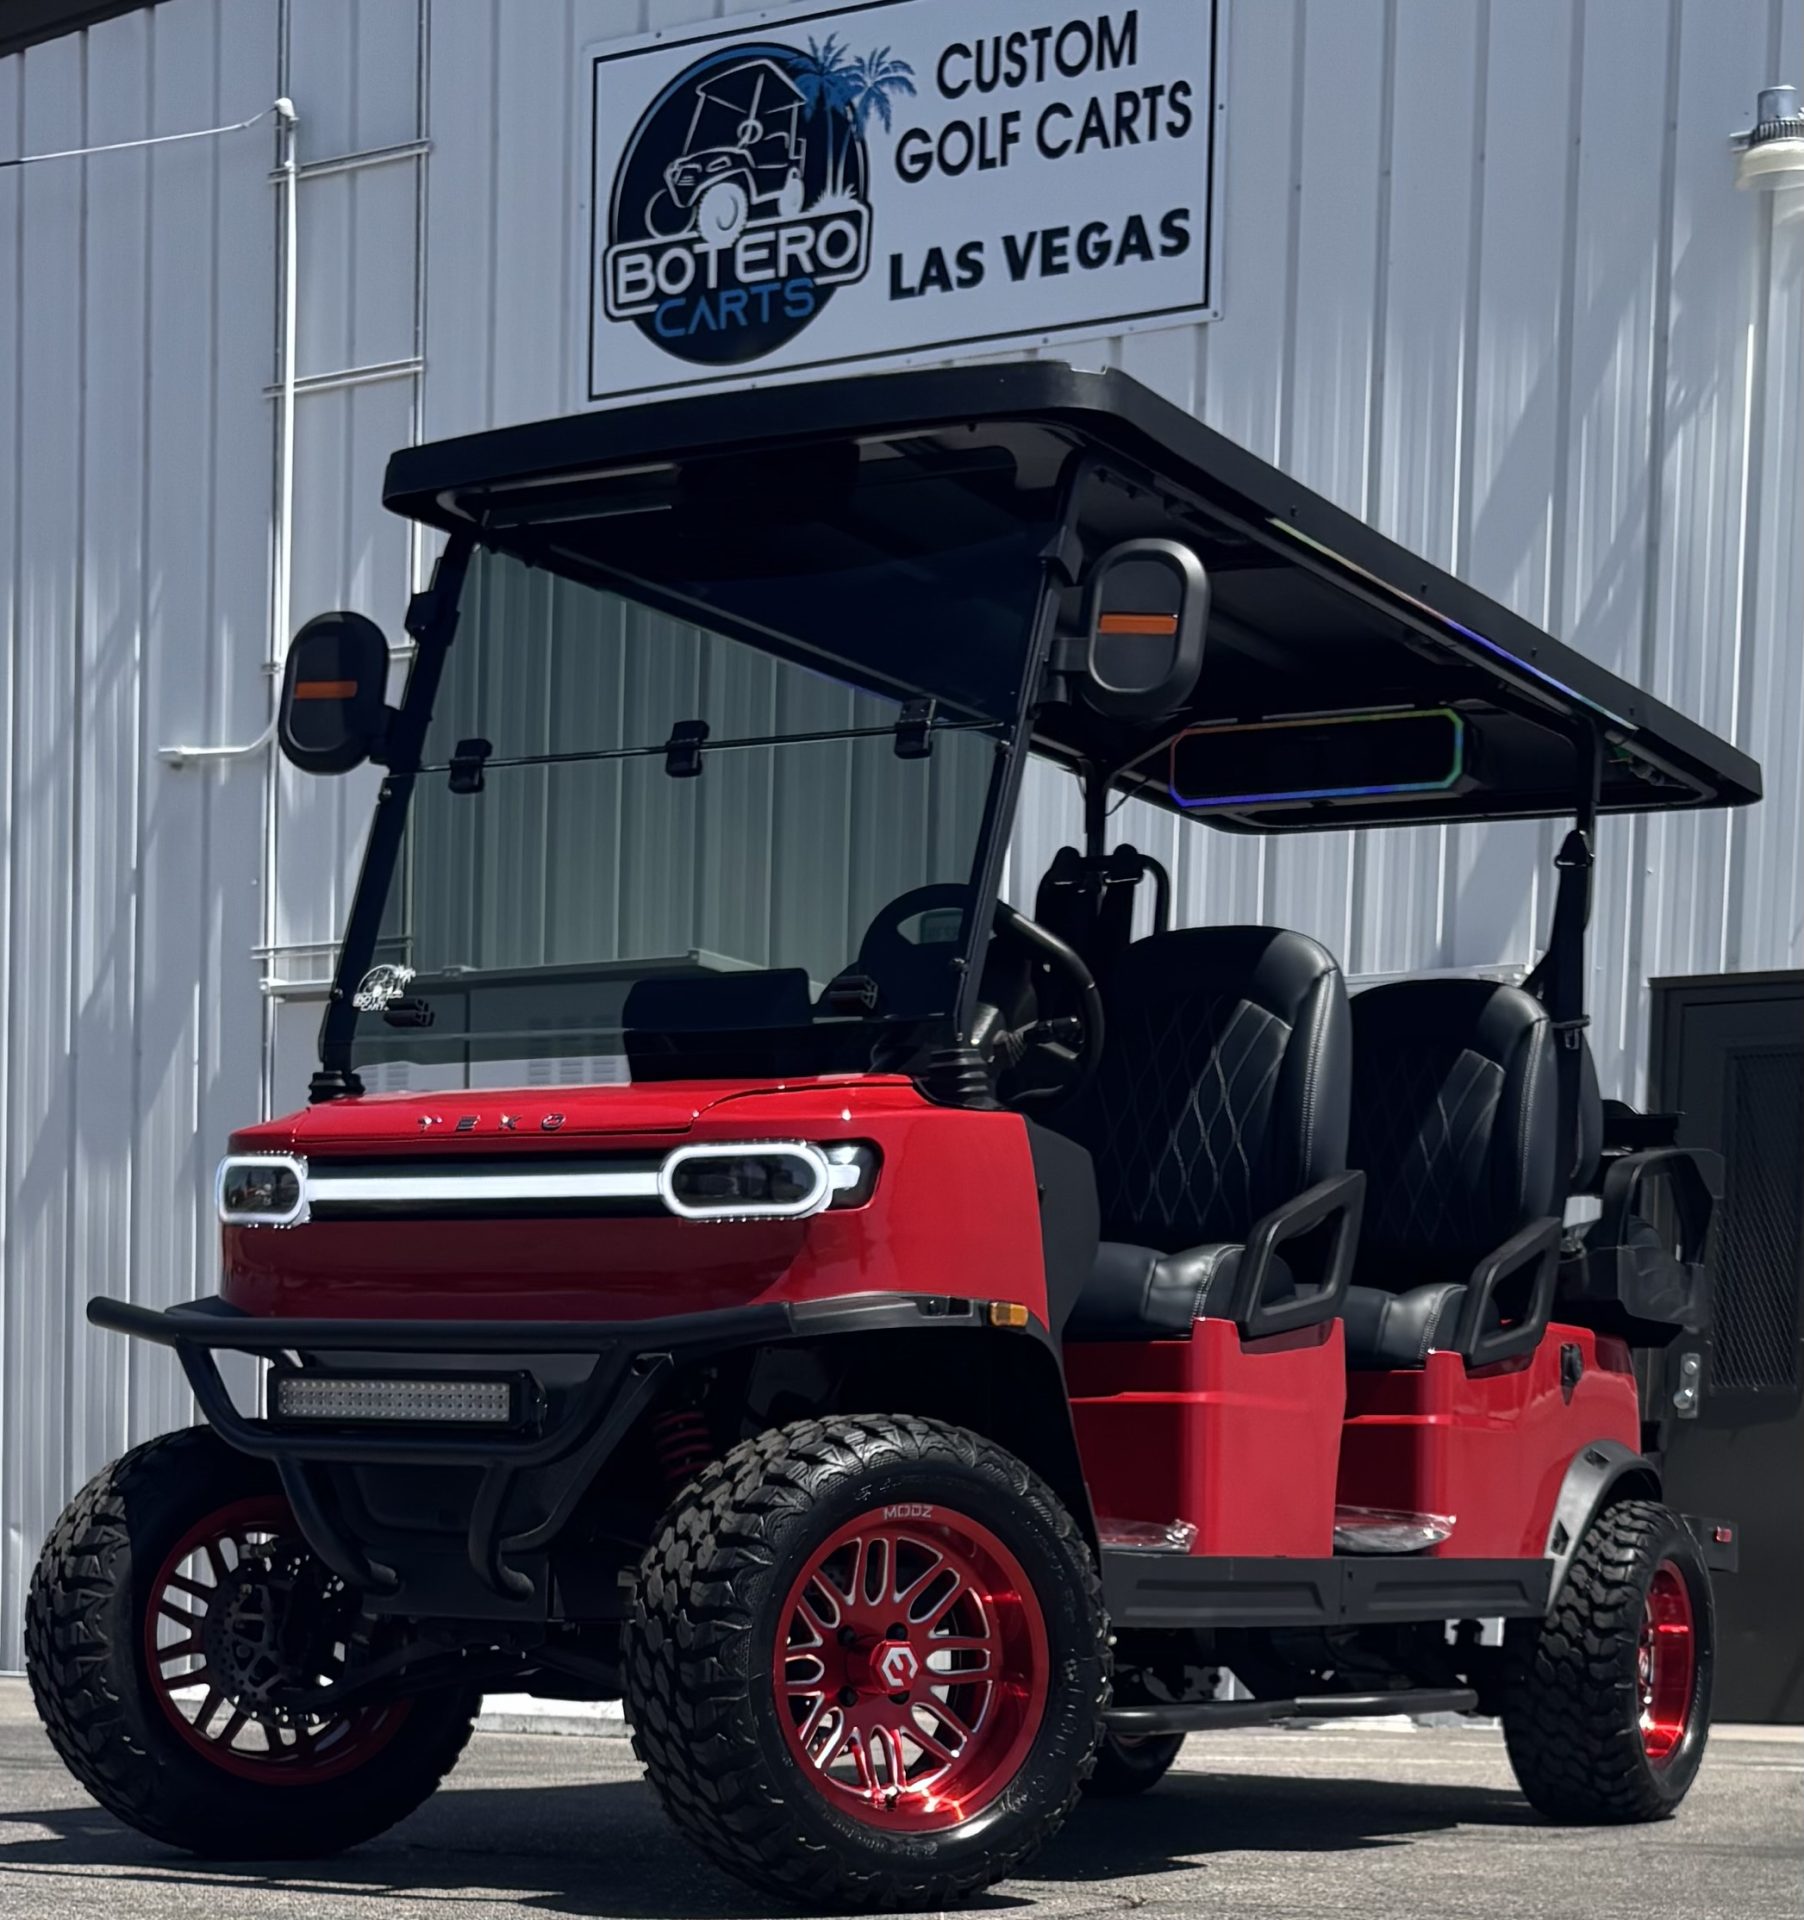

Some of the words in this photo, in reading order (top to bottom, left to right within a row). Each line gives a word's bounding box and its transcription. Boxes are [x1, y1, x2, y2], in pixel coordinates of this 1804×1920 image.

[937, 9, 1139, 99] CUSTOM
[895, 110, 1021, 184] GOLF
[1036, 80, 1193, 159] CARTS
[617, 219, 859, 304] BOTERO
[889, 241, 985, 301] LAS
[1002, 208, 1191, 282] VEGAS
[655, 277, 816, 339] CARTS
[417, 1112, 567, 1134] TEKO
[883, 1503, 933, 1520] MODZ
